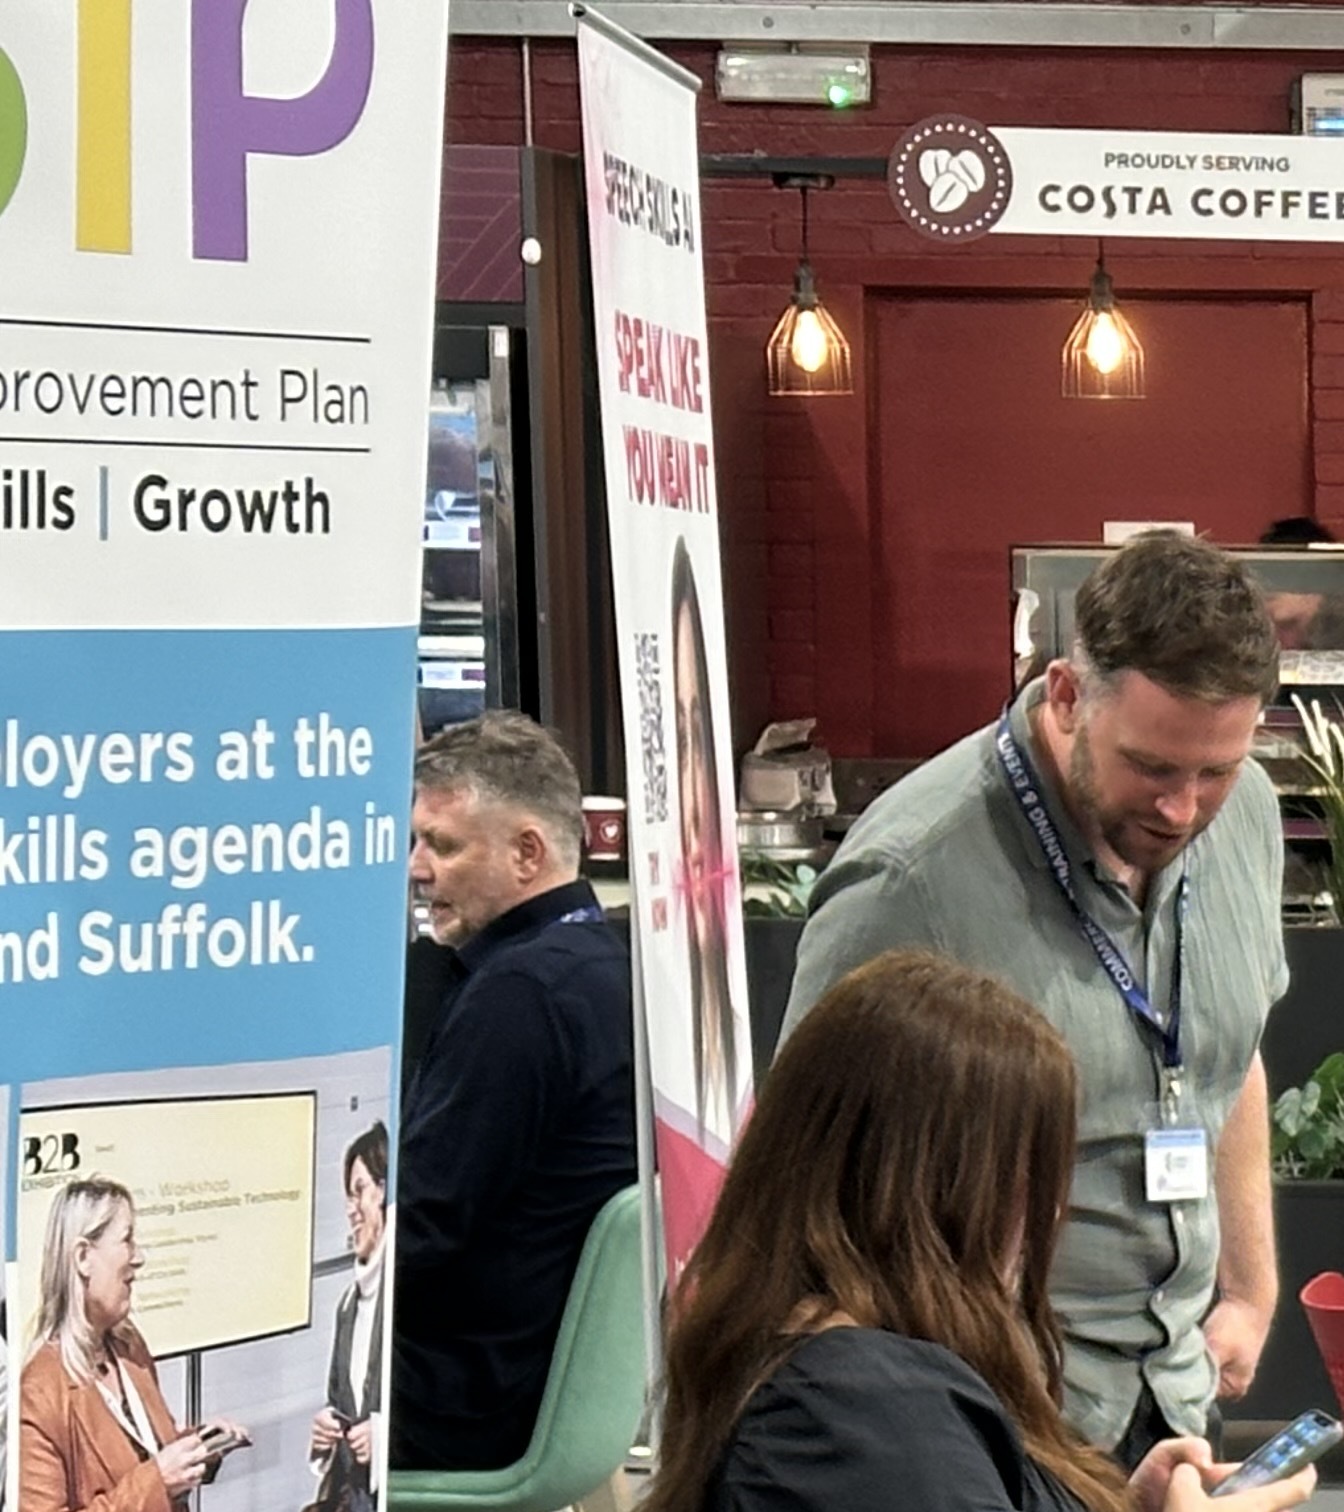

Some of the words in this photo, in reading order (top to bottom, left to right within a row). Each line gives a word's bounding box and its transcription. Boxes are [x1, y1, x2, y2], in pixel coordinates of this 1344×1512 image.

[1104, 152, 1197, 170] PROUDLY
[1201, 154, 1291, 173] SERVING
[1037, 183, 1173, 219] COSTA
[613, 308, 667, 404] SPEAK
[667, 329, 704, 414] LIKE
[279, 367, 370, 425] Plan
[622, 424, 656, 506] YOU
[656, 432, 693, 511] MEAN
[694, 442, 711, 514] IT
[132, 473, 331, 535] Growth
[5, 717, 195, 799] loyers
[215, 717, 276, 782] at
[293, 711, 374, 779] the
[996, 731, 1030, 789] EVENT
[1021, 789, 1038, 804] &
[129, 804, 351, 890] agenda
[364, 800, 396, 867] in
[0, 911, 60, 984] nd
[77, 898, 315, 977] Suffolk.
[23, 1132, 82, 1175] B2B
